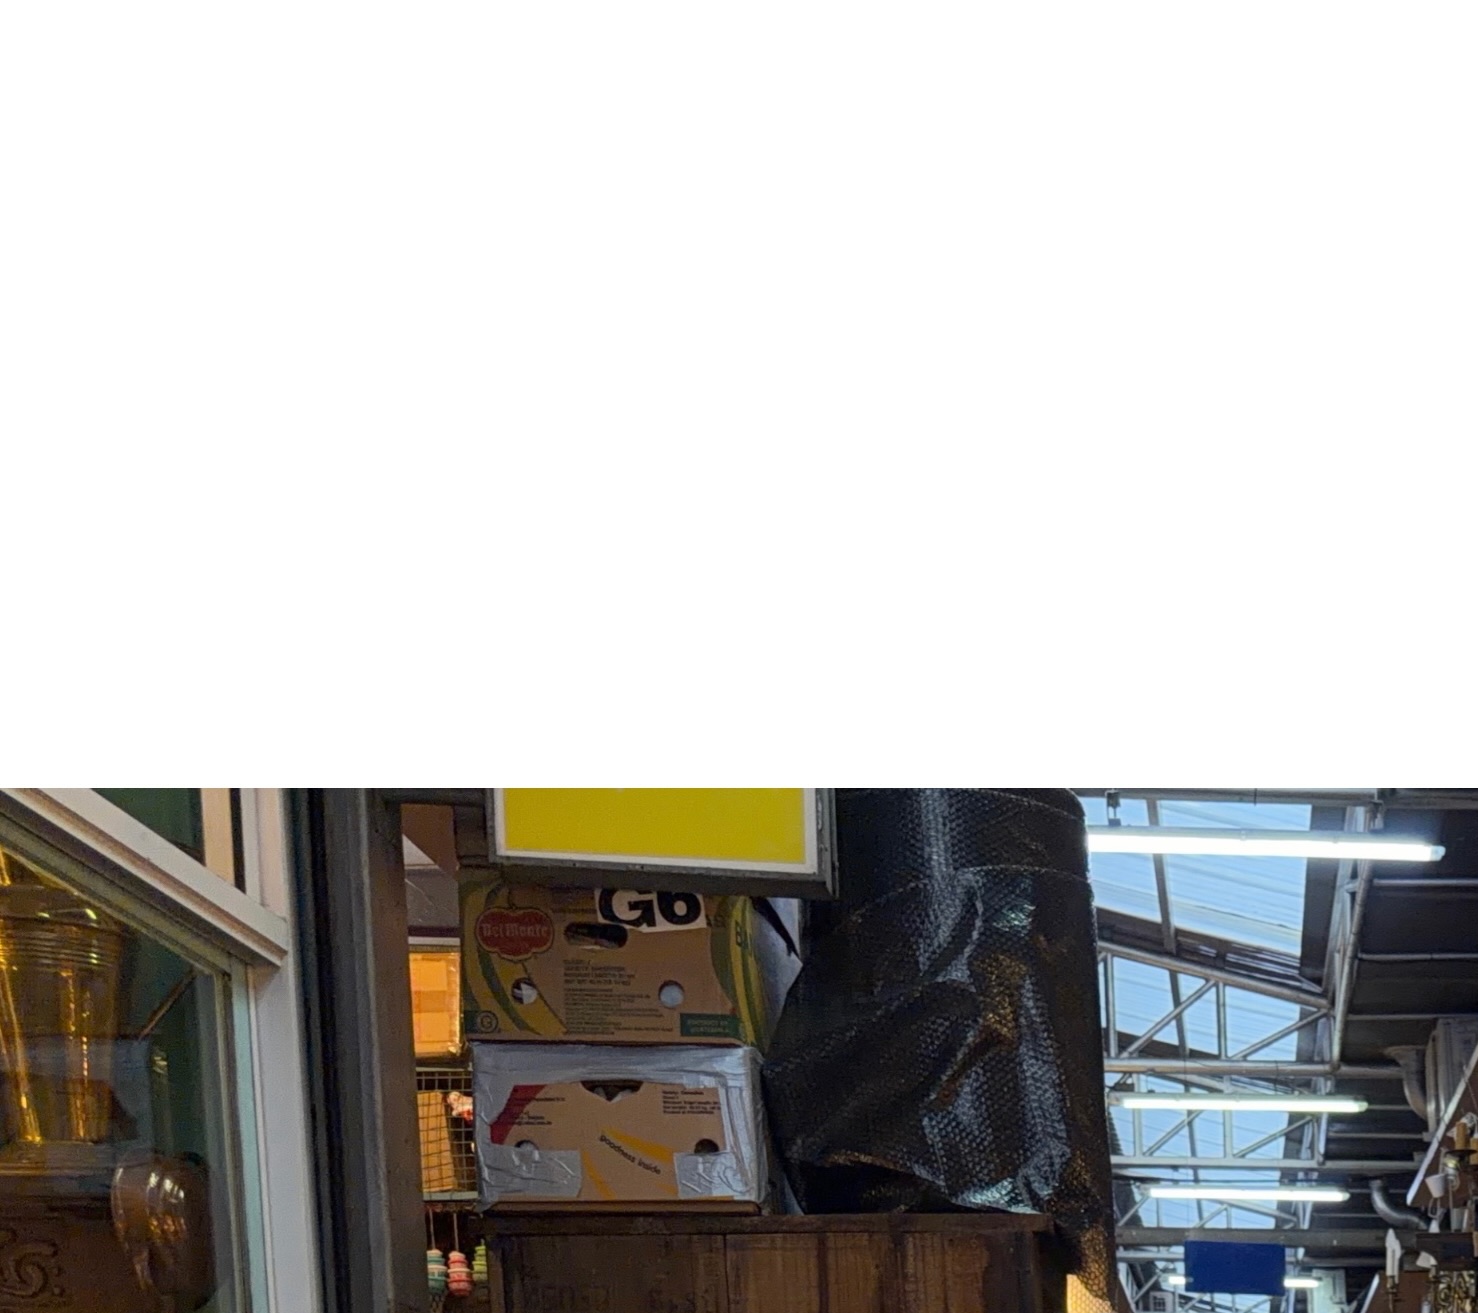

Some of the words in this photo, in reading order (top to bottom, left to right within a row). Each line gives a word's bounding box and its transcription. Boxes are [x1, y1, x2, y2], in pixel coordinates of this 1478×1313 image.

[505, 922, 548, 938] Monte
[599, 1135, 636, 1163] goodness
[637, 1157, 661, 1175] inside
